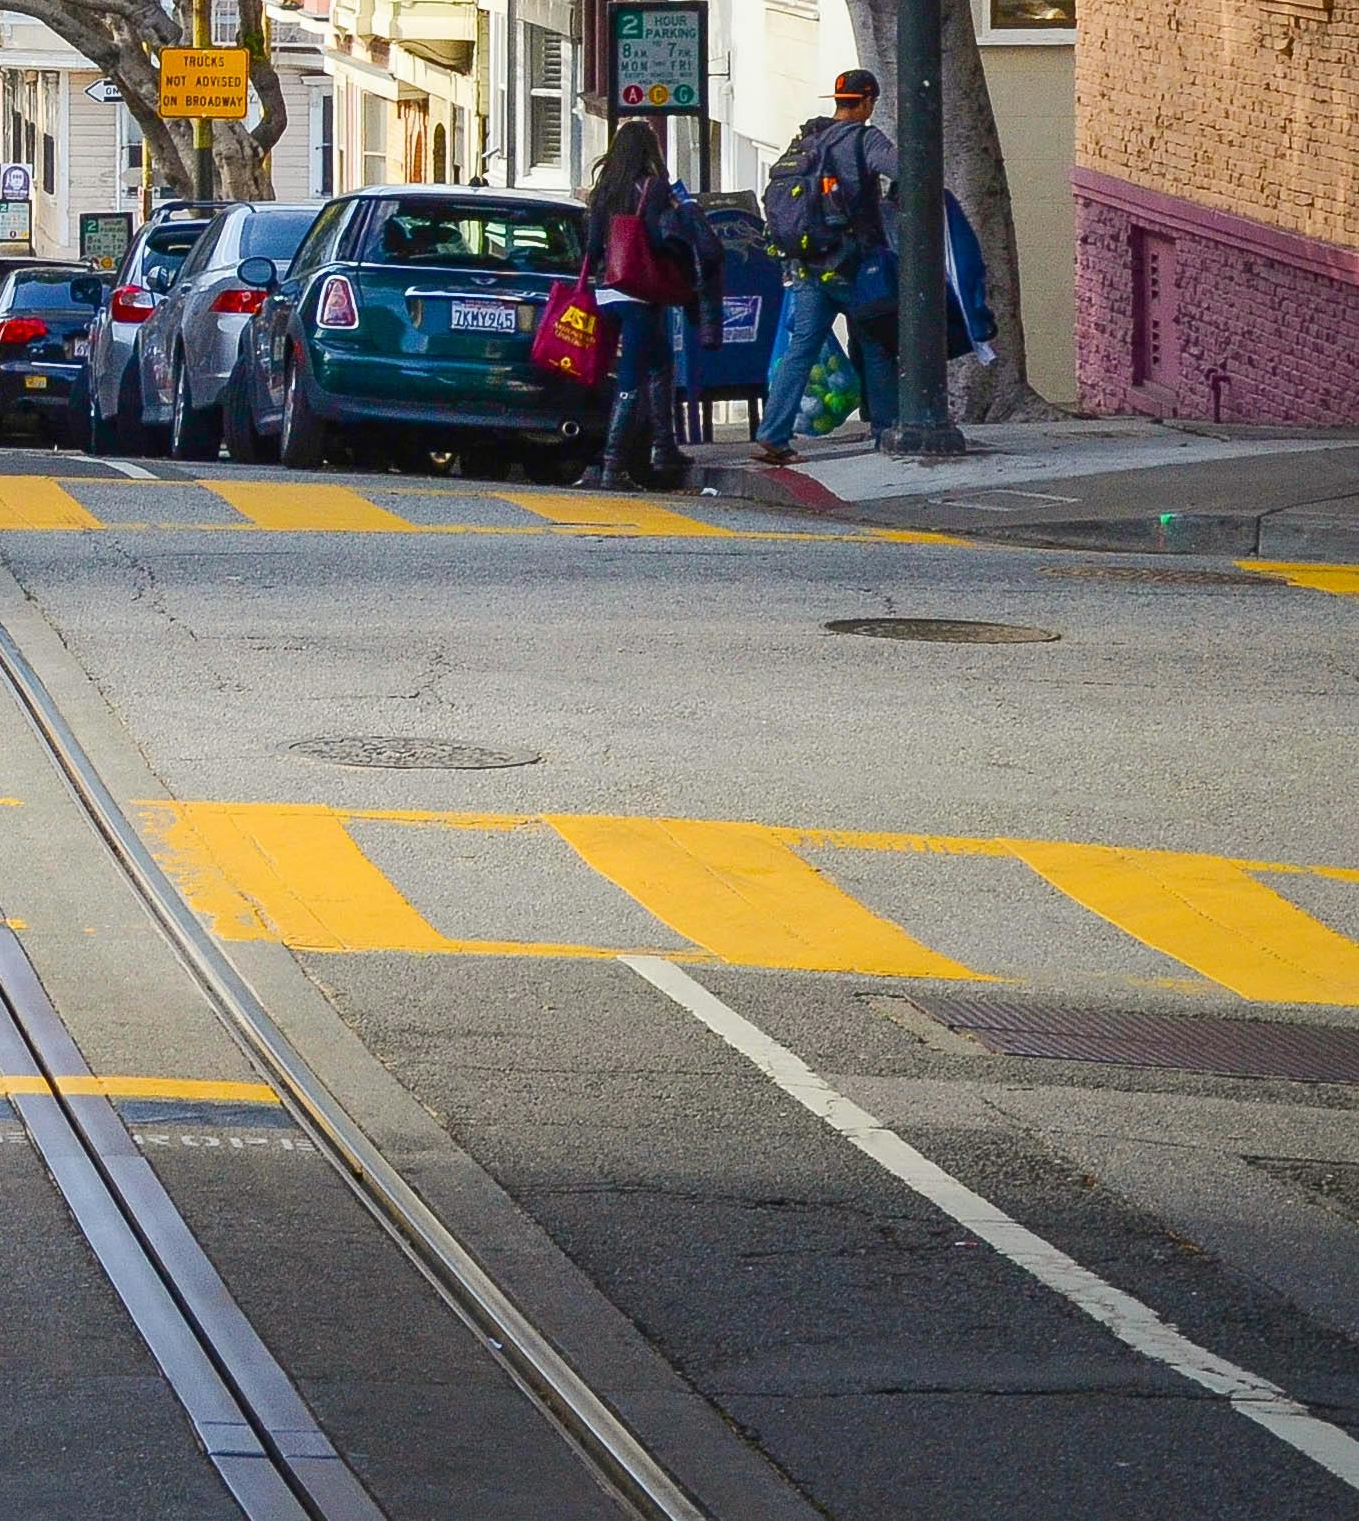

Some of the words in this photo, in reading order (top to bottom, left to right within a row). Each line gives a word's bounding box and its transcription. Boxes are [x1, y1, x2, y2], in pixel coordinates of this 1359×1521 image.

[622, 15, 638, 34] 2
[655, 16, 688, 26] HOUR
[645, 28, 696, 38] PARKING
[183, 56, 225, 67] TRUCKS
[621, 61, 648, 71] MON
[166, 76, 187, 87] NOT
[196, 76, 241, 88] ADVISED
[105, 86, 119, 96] ON
[163, 95, 178, 106] ON
[186, 95, 243, 107] BROADWAY
[87, 220, 97, 231] 2
[454, 309, 513, 330] 7KMY945
